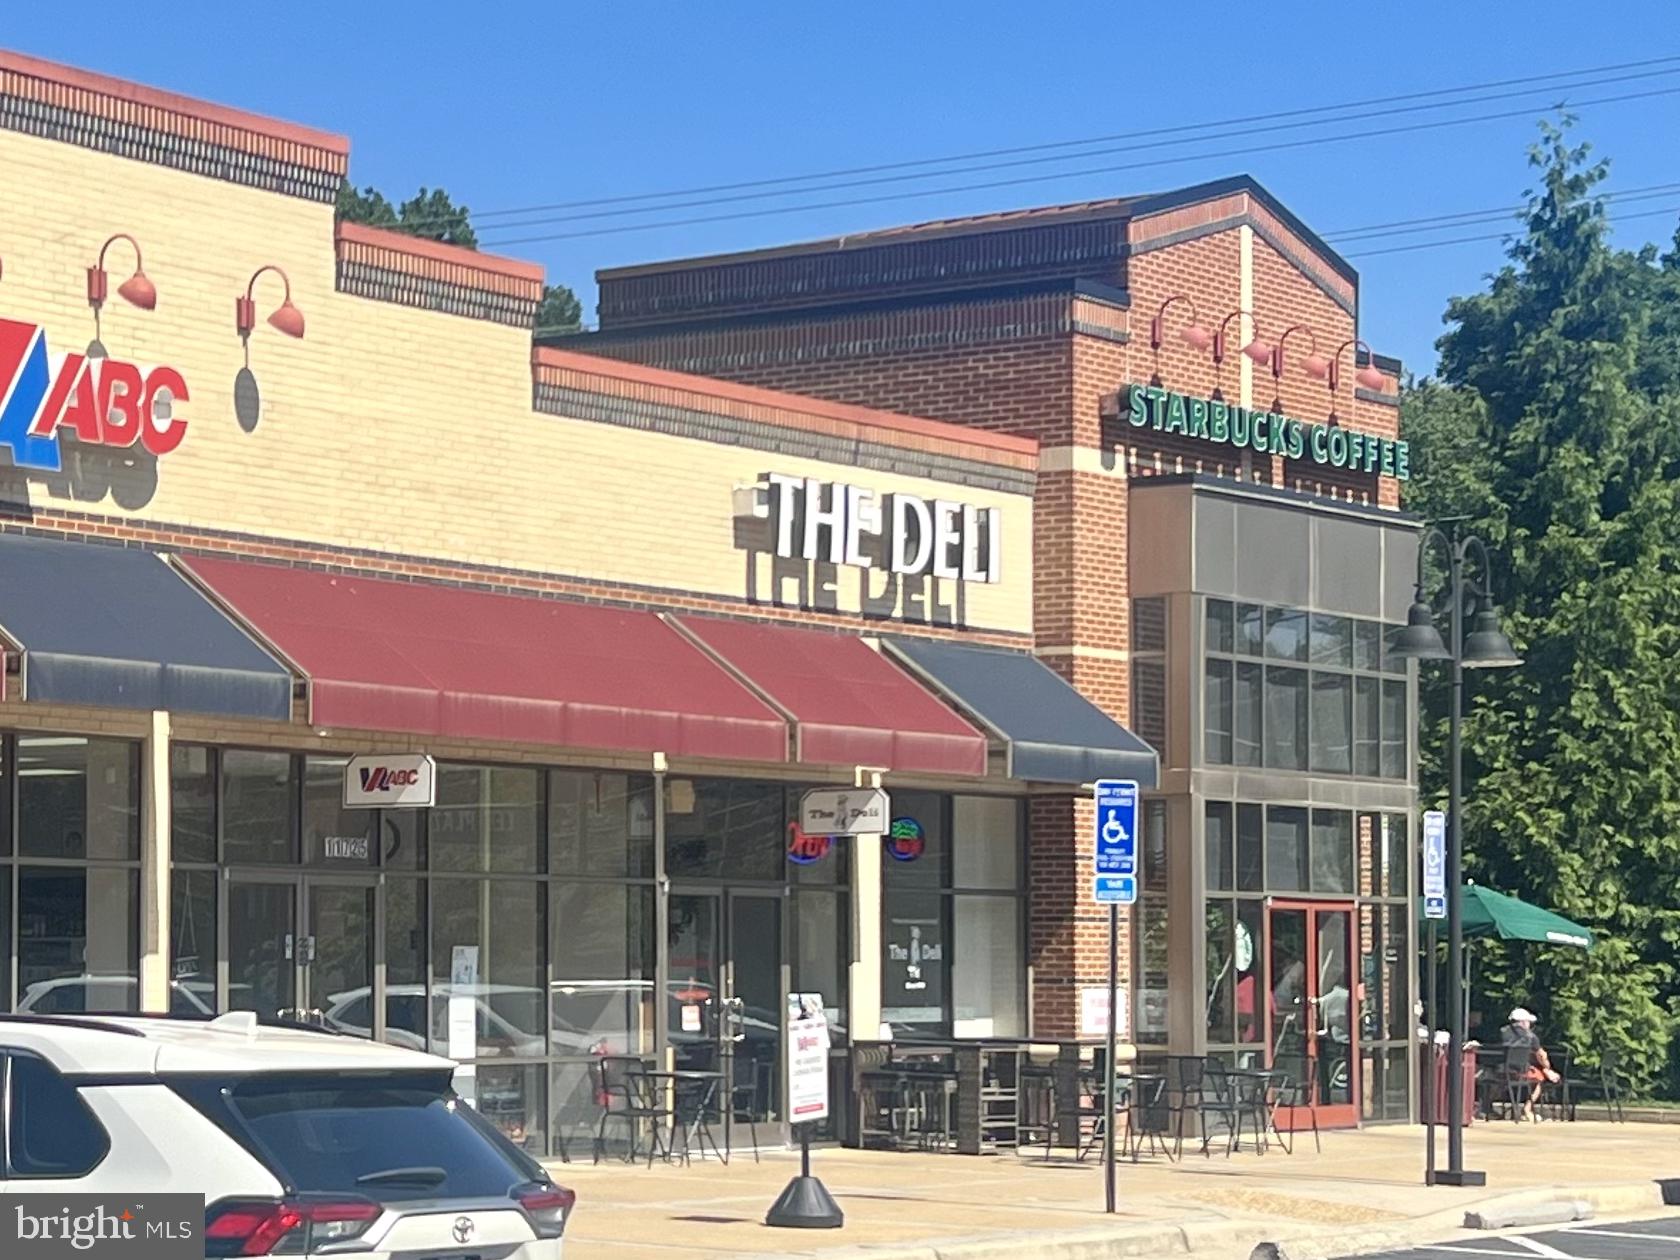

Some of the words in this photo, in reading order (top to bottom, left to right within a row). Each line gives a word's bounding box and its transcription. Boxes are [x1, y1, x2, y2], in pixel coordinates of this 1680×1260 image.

[28, 352, 190, 456] ABC
[1128, 384, 1304, 461] STARBUCKS
[1310, 422, 1411, 481] COFFEE
[764, 471, 877, 568] THE
[889, 491, 1001, 584] DELI
[388, 769, 419, 786] ABC
[808, 808, 835, 819] The
[850, 808, 880, 819] Deli
